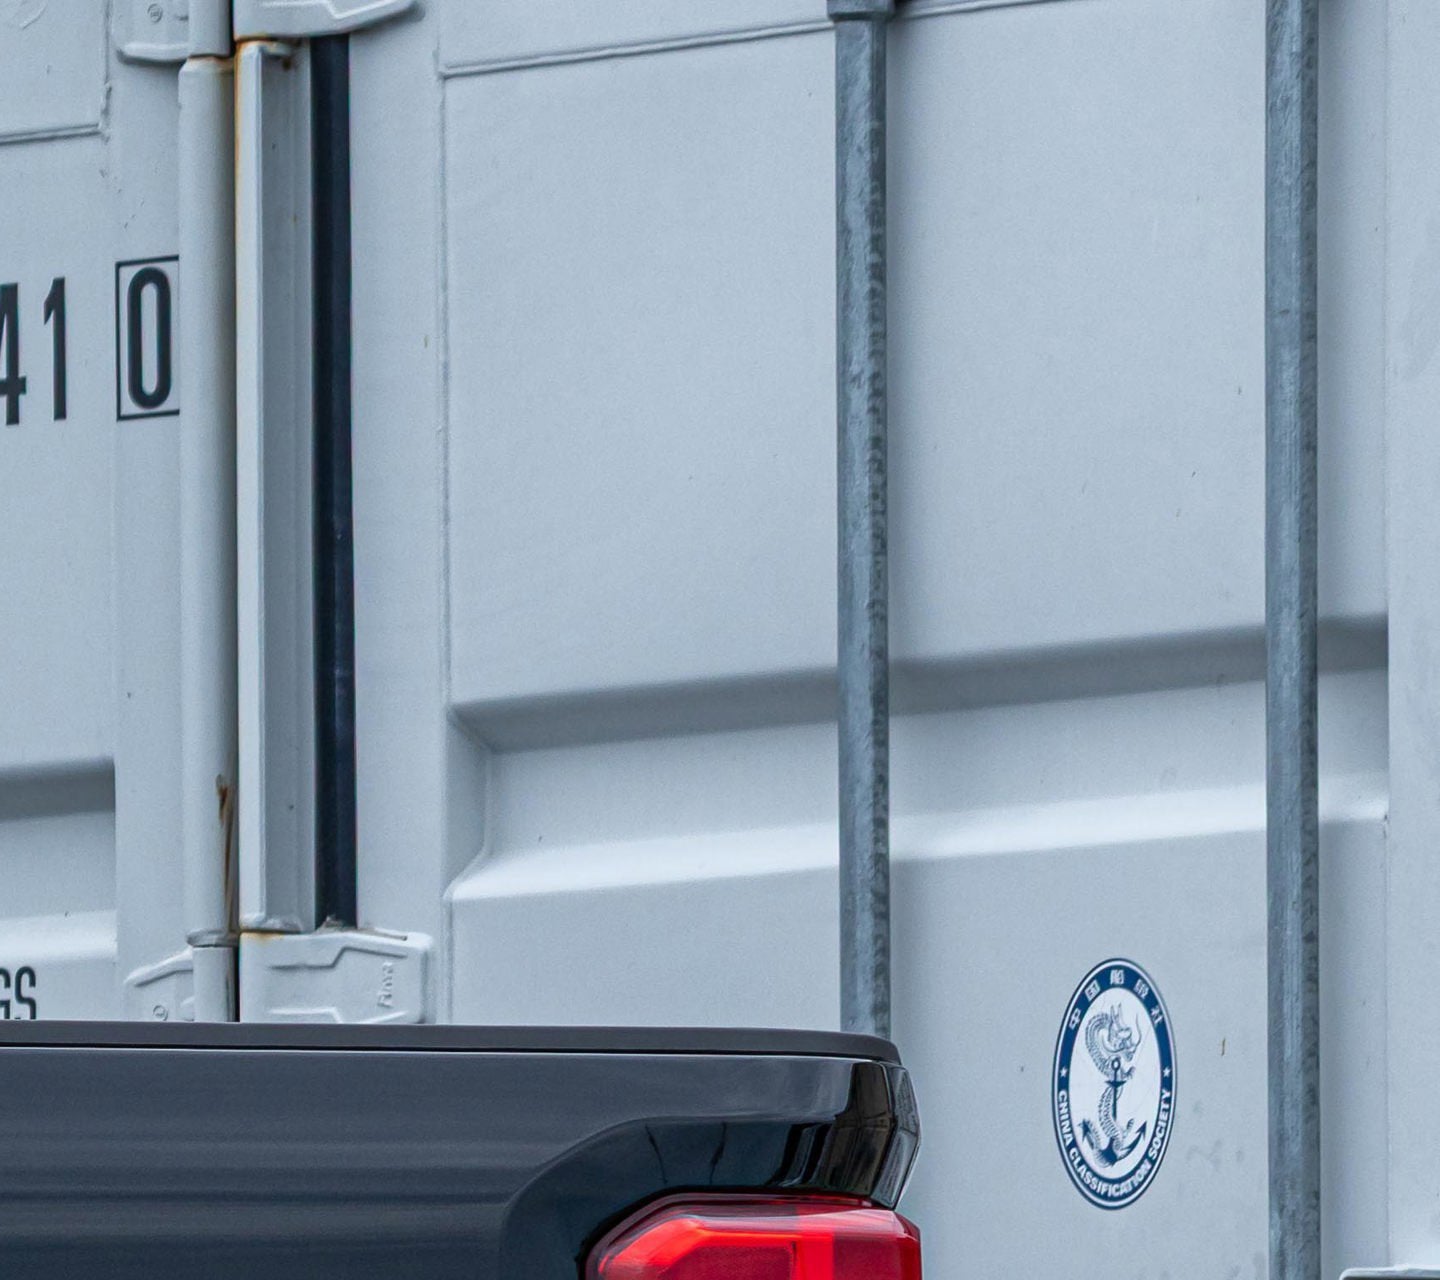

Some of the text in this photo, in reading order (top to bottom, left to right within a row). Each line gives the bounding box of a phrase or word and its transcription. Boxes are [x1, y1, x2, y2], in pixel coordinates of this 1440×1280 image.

[1057, 1090, 1172, 1199] CHINA CLASSIFICATION SOCIETY
